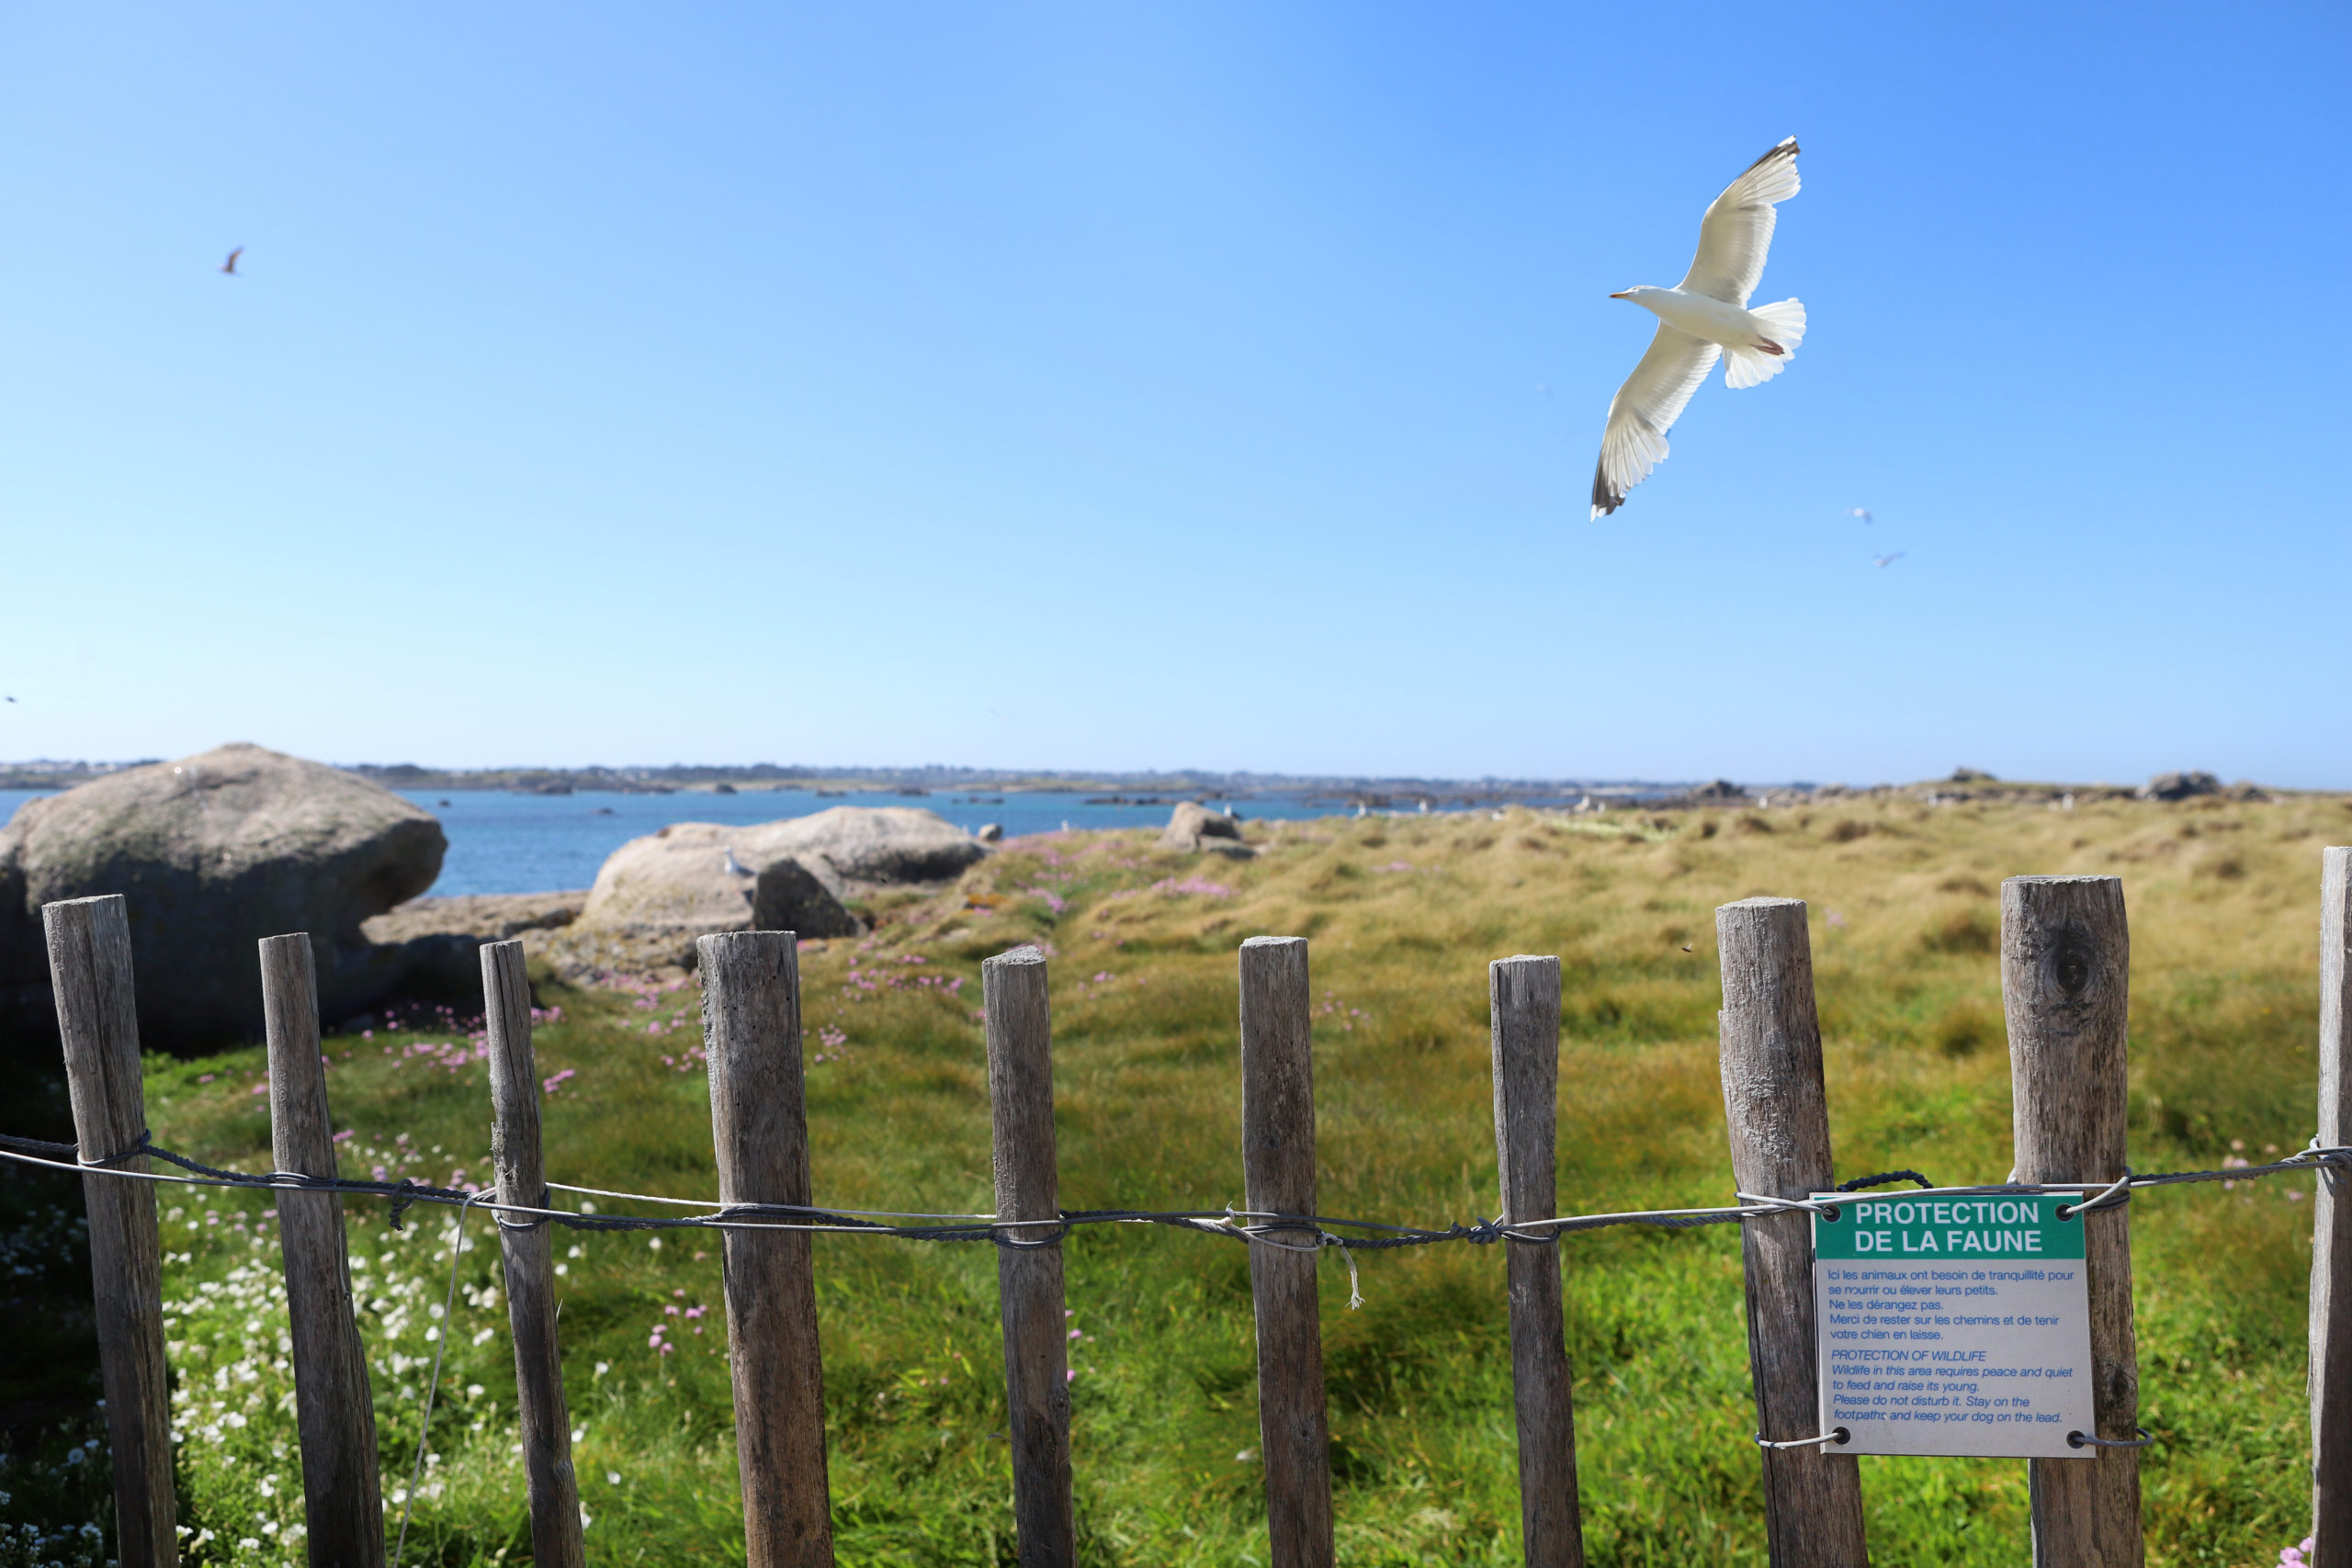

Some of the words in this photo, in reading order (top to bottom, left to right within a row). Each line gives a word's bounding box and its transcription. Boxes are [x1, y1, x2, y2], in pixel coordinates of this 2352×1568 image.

[1856, 1202, 2039, 1224] PROTECTION
[1855, 1231, 1893, 1251] DE
[1903, 1231, 1939, 1251] LA
[1948, 1230, 2042, 1251] FAUNE
[1828, 1269, 1840, 1280] Ici
[1843, 1269, 1859, 1280] les
[1861, 1270, 1907, 1280] animaux
[1910, 1271, 1928, 1280] ont
[1931, 1269, 1969, 1280] besoin
[1971, 1270, 1985, 1280] de
[1989, 1269, 2045, 1281] tranquillité
[2048, 1271, 2075, 1281] pour
[1829, 1286, 1842, 1295] se
[1883, 1287, 1897, 1295] ou
[1900, 1286, 1932, 1295] élever
[1935, 1286, 1962, 1295] leurs
[1965, 1286, 1998, 1296] petits.
[1829, 1299, 1845, 1310] Ne
[1848, 1299, 1863, 1310] les
[1866, 1300, 1917, 1312] dérangez
[1920, 1302, 1943, 1311] pas.
[1830, 1314, 1860, 1325] Merci
[1863, 1314, 1877, 1325] de
[1881, 1315, 1911, 1325] rester
[1935, 1314, 1951, 1325] les
[1953, 1315, 2000, 1325] chemins
[2003, 1316, 2014, 1325] et
[2018, 1314, 2031, 1325] de
[2035, 1315, 2059, 1325] tenir
[1830, 1330, 1858, 1339] votre
[1860, 1330, 1890, 1339] chien
[1893, 1331, 1907, 1339] en
[1910, 1330, 1943, 1340] laisse.
[1831, 1349, 1909, 1360] PROTECTION
[1911, 1350, 1929, 1361] OF
[1931, 1350, 1985, 1361] WILDLIFE
[1832, 1364, 1871, 1375] Wildlife
[1873, 1365, 1883, 1374] in
[1885, 1366, 1905, 1376] this
[1908, 1368, 1932, 1376] area
[1935, 1367, 1979, 1377] requires
[1982, 1368, 2018, 1377] peace
[2020, 1368, 2042, 1377] and
[2045, 1367, 2073, 1378] quiet
[1833, 1381, 1844, 1390] to
[1847, 1380, 1871, 1390] feed
[1873, 1381, 1895, 1391] and
[1898, 1382, 1924, 1391] raise
[1927, 1382, 1939, 1391] its
[1942, 1383, 1979, 1393] young.
[1834, 1393, 1870, 1404] Please
[1872, 1395, 1888, 1405] do
[1890, 1395, 1908, 1405] not
[1911, 1395, 1950, 1405] disturb
[1952, 1395, 1961, 1405] it.
[1966, 1396, 1991, 1407] Stay
[2011, 1396, 2030, 1406] the
[1834, 1409, 1886, 1421] footpaths
[1890, 1411, 1911, 1420] and
[1914, 1411, 1940, 1422] keep
[1944, 1413, 1969, 1422] your
[1972, 1412, 1994, 1424] dog
[2014, 1411, 2032, 1422] the
[2035, 1413, 2062, 1423] lead.
